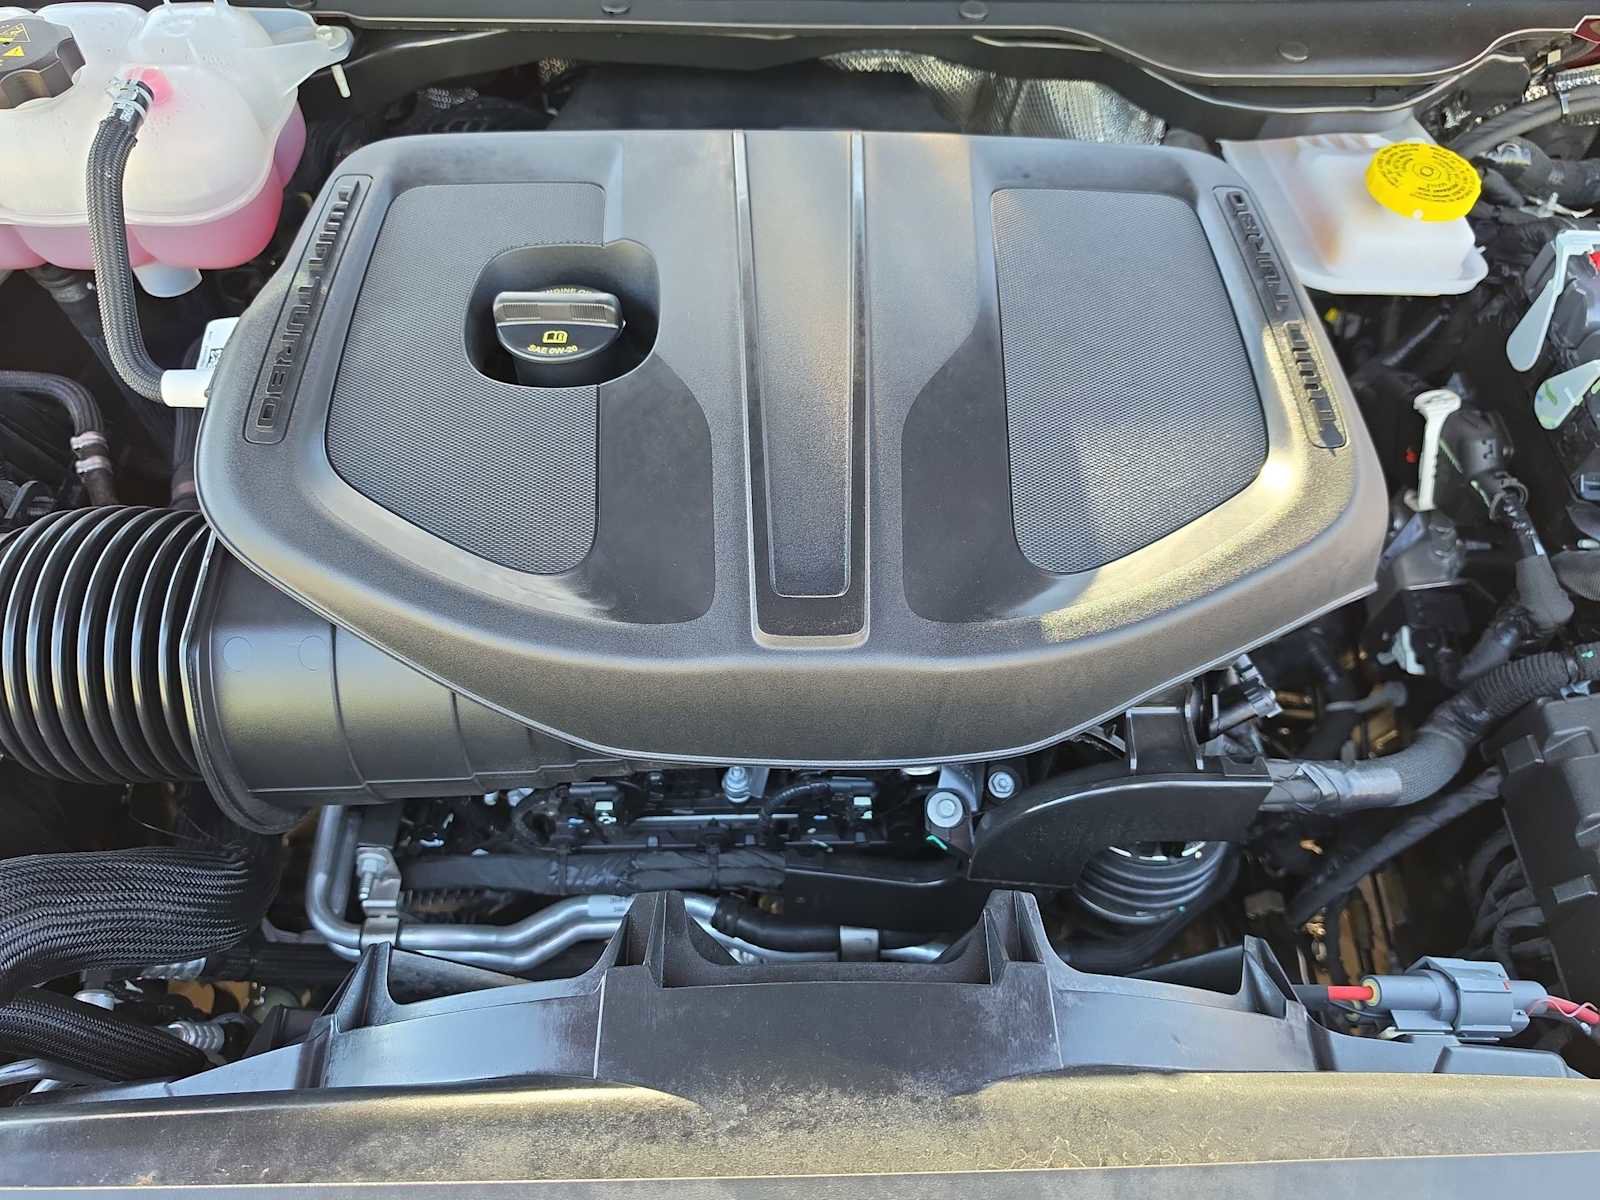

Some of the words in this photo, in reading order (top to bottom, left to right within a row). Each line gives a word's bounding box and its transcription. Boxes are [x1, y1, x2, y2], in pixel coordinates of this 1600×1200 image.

[1226, 191, 1289, 313] TURBO
[256, 276, 322, 433] TURBO
[528, 344, 548, 353] SAE
